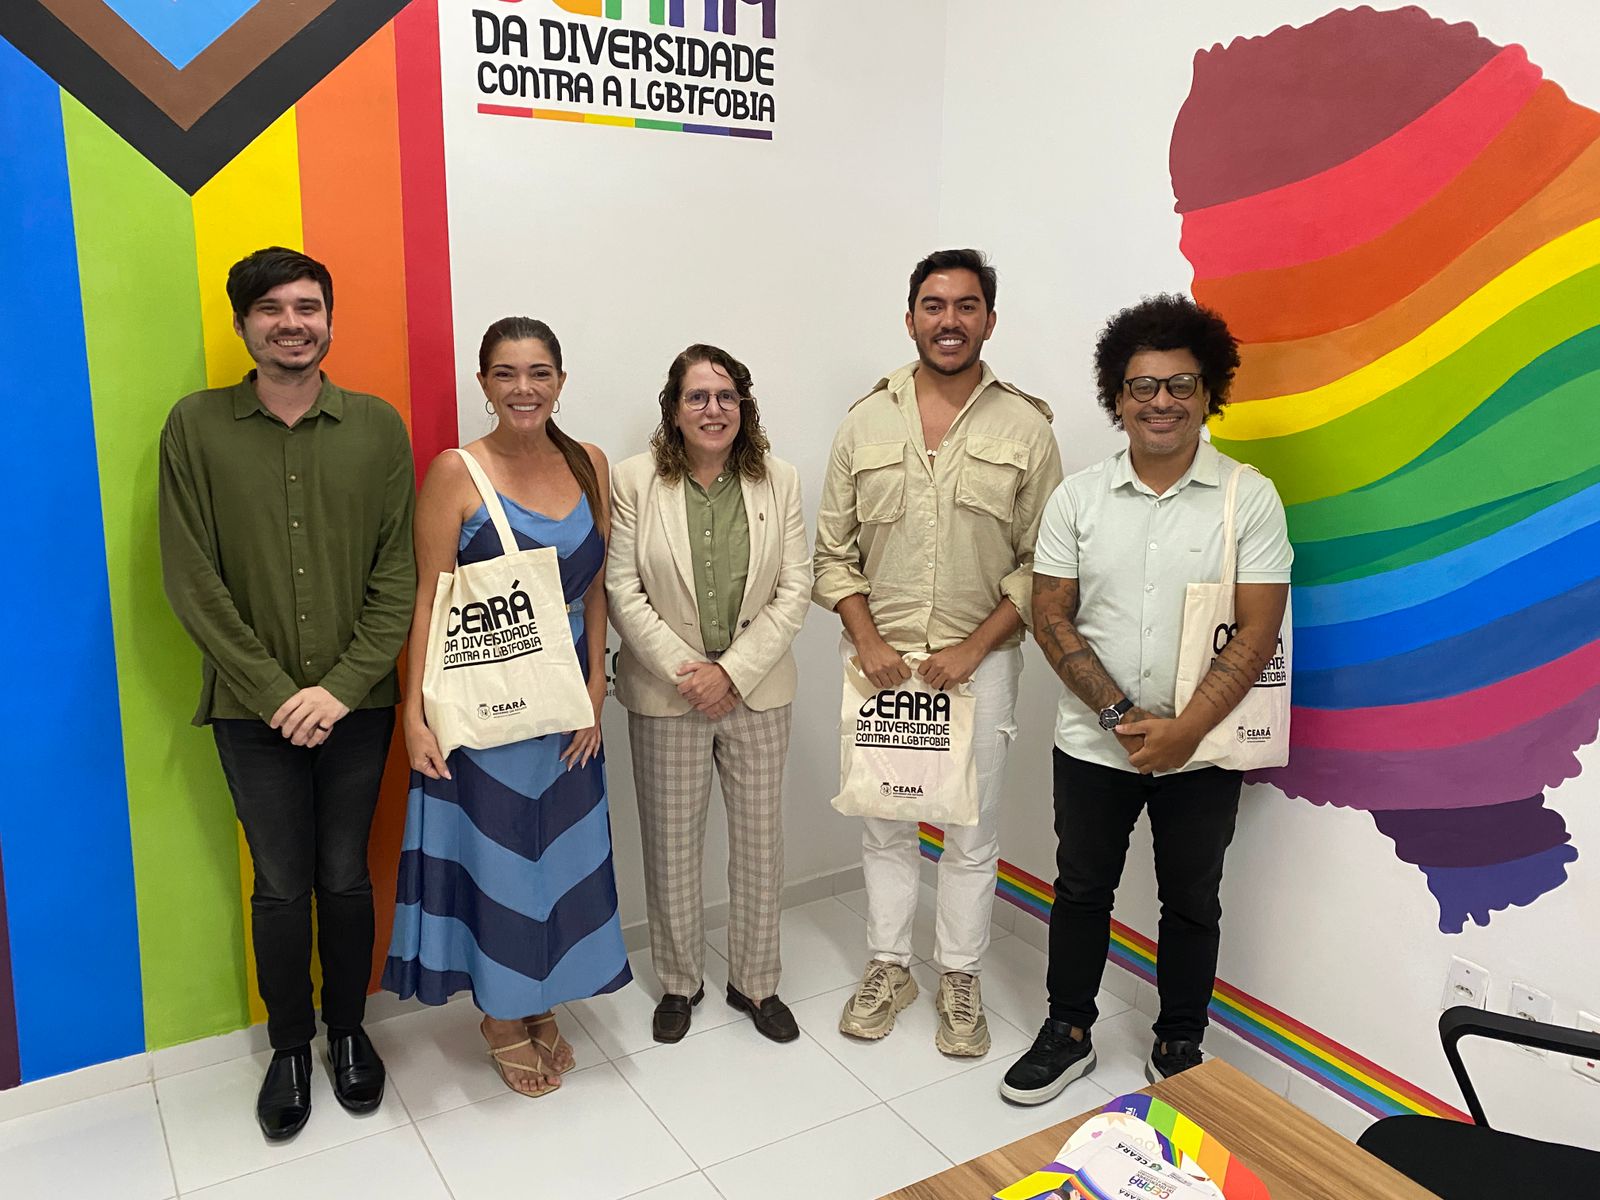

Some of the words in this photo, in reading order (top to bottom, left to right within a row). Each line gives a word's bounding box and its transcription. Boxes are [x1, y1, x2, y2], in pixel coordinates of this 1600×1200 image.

[472, 9, 528, 58] DA
[539, 18, 775, 87] DIVERSIDADE
[477, 60, 594, 104] CONTRA
[602, 75, 623, 107] A
[630, 77, 776, 123] LGBTFOBIA
[446, 579, 535, 637] CEARÁ
[443, 650, 480, 665] CONTRA
[483, 648, 491, 659] A
[493, 636, 542, 658] LBTFOBIA
[444, 638, 458, 654] DA
[491, 697, 527, 713] CEARÁ
[856, 719, 871, 732] DA
[874, 721, 950, 736] DIVERSIDADE
[1246, 726, 1271, 737] CEARÁ
[855, 733, 891, 744] CONTRA
[892, 734, 899, 744] A
[901, 736, 950, 747] LGBTFOBIA
[892, 785, 924, 794] CEARÁ
[1116, 1142, 1148, 1165] CEARÁ
[1128, 1175, 1170, 1200] CEARÁ
